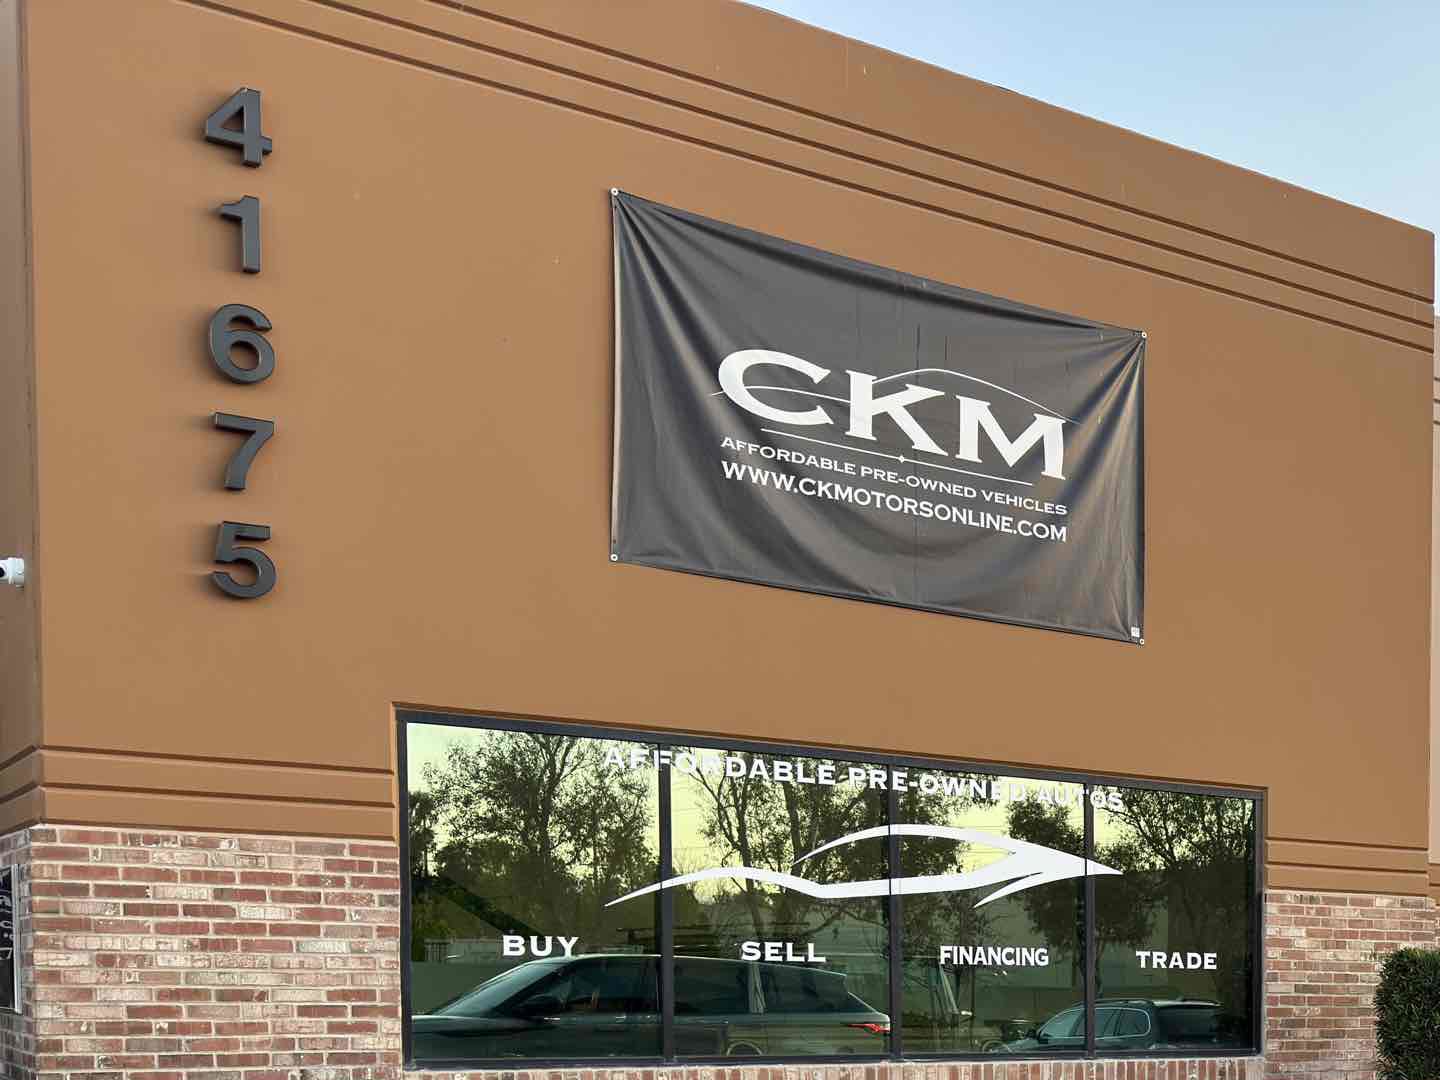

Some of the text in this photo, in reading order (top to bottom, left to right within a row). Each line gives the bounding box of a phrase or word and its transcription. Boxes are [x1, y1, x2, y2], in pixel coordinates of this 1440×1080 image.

[204, 86, 277, 600] 41675
[718, 349, 1066, 480] CKM
[721, 437, 1068, 516] AFFORDABLE PRE-OWNED VEHICLES
[721, 460, 1067, 542] WWW.CKMOTORSONLINE.COM
[849, 767, 1029, 802] PRE-OWNED
[502, 935, 579, 958] BUY
[741, 941, 827, 963] SELL
[939, 945, 1049, 966] FINANCING
[1136, 950, 1217, 970] TRADE
